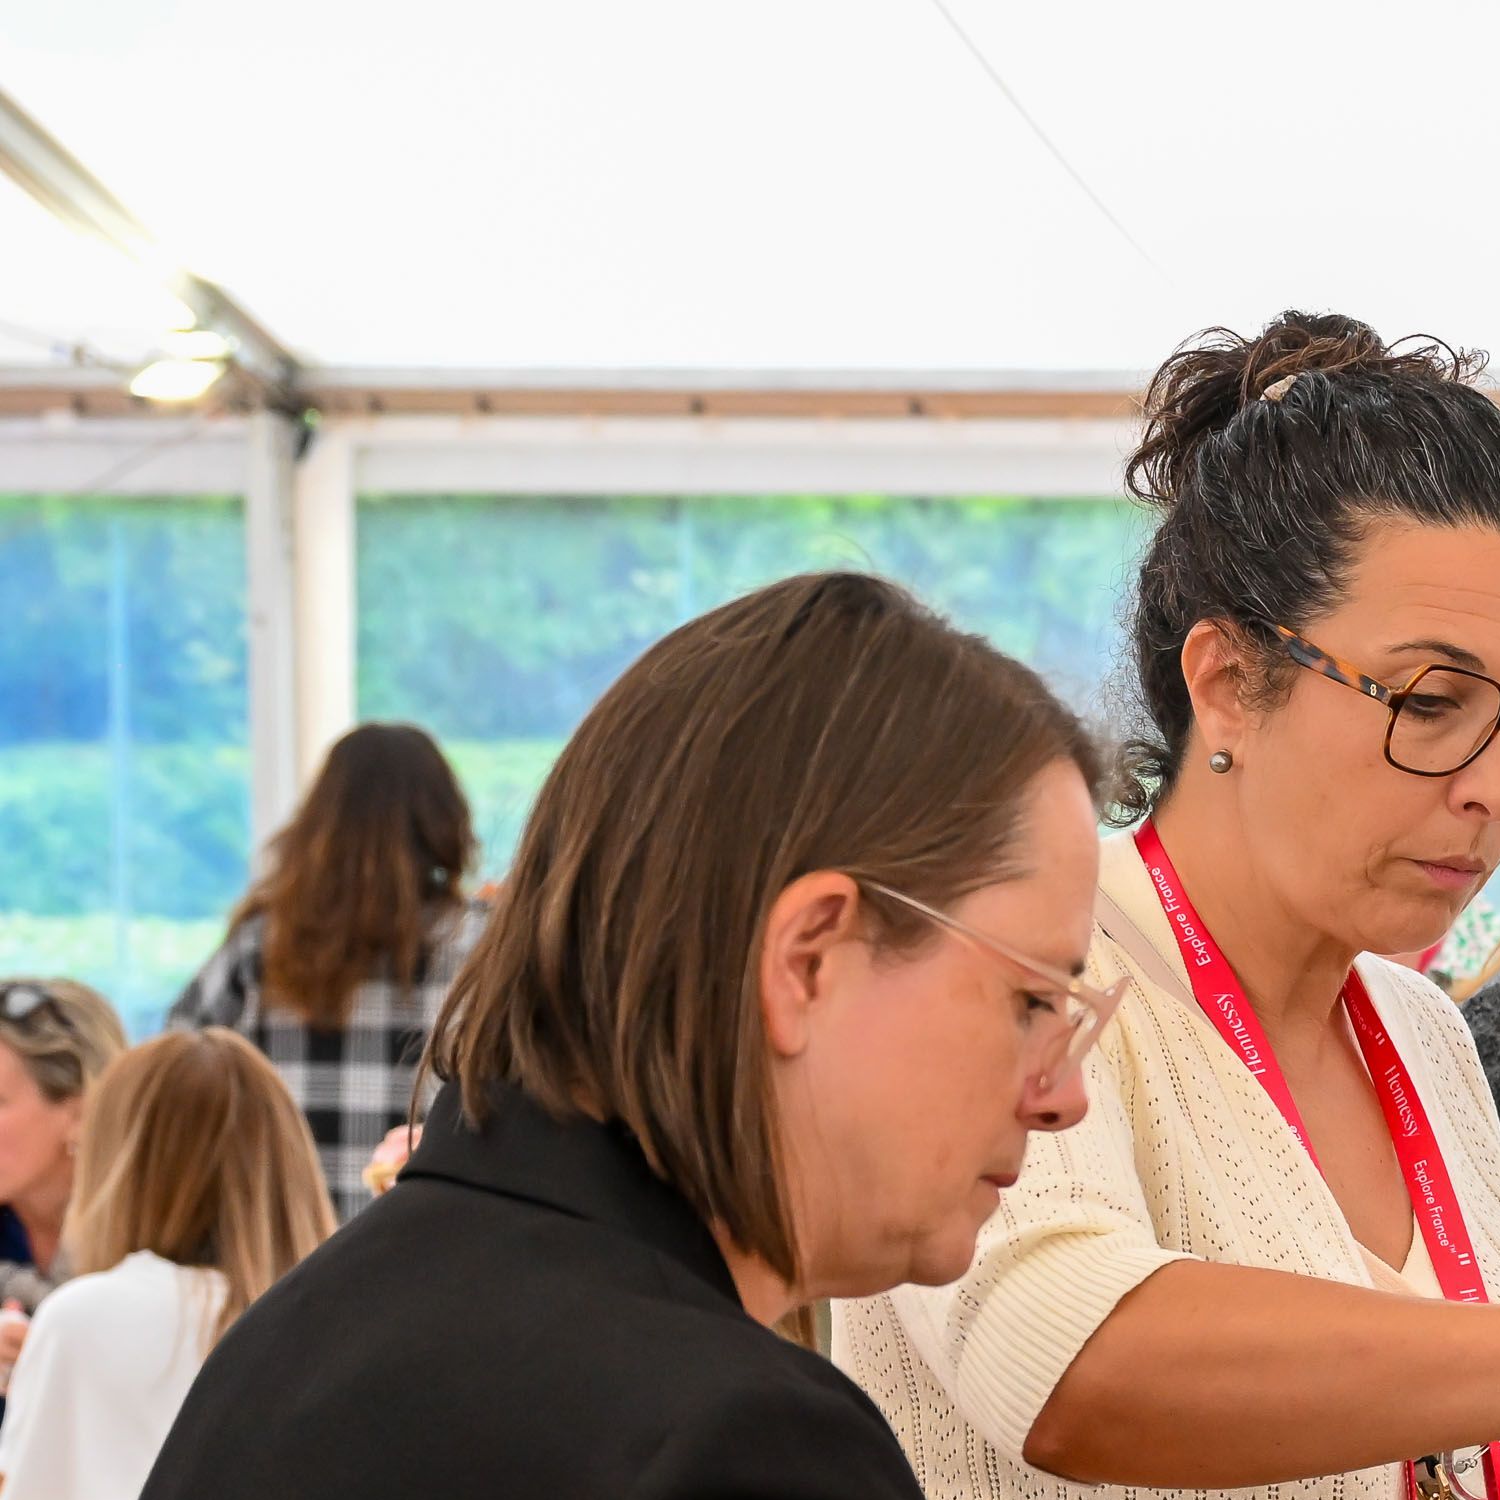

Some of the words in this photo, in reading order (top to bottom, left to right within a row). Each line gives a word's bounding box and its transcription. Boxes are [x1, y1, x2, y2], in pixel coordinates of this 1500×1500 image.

[1175, 912, 1212, 967] Explore
[1213, 991, 1267, 1077] Hennessy
[1384, 1064, 1421, 1139] Hennessy
[1412, 1158, 1436, 1206] Explore
